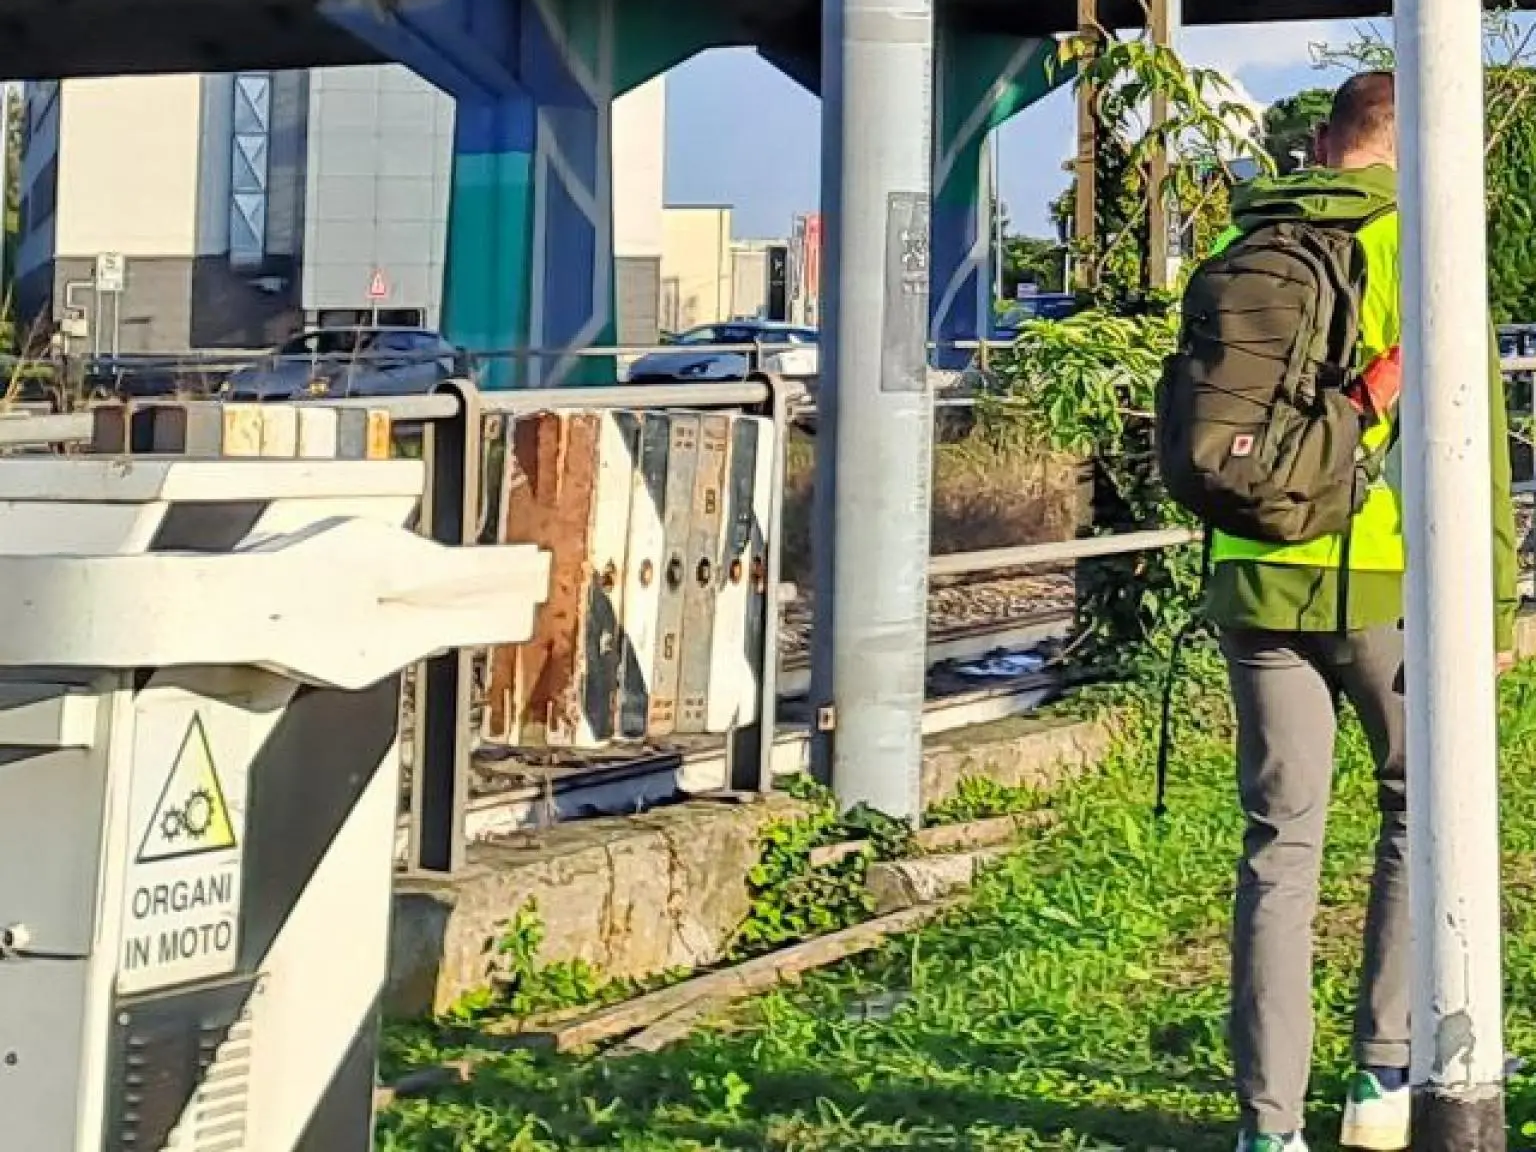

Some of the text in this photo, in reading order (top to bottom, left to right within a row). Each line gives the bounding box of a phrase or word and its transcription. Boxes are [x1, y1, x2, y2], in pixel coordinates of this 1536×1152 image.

[132, 872, 232, 919] ORGANI
[124, 920, 231, 969] IN MOTO
